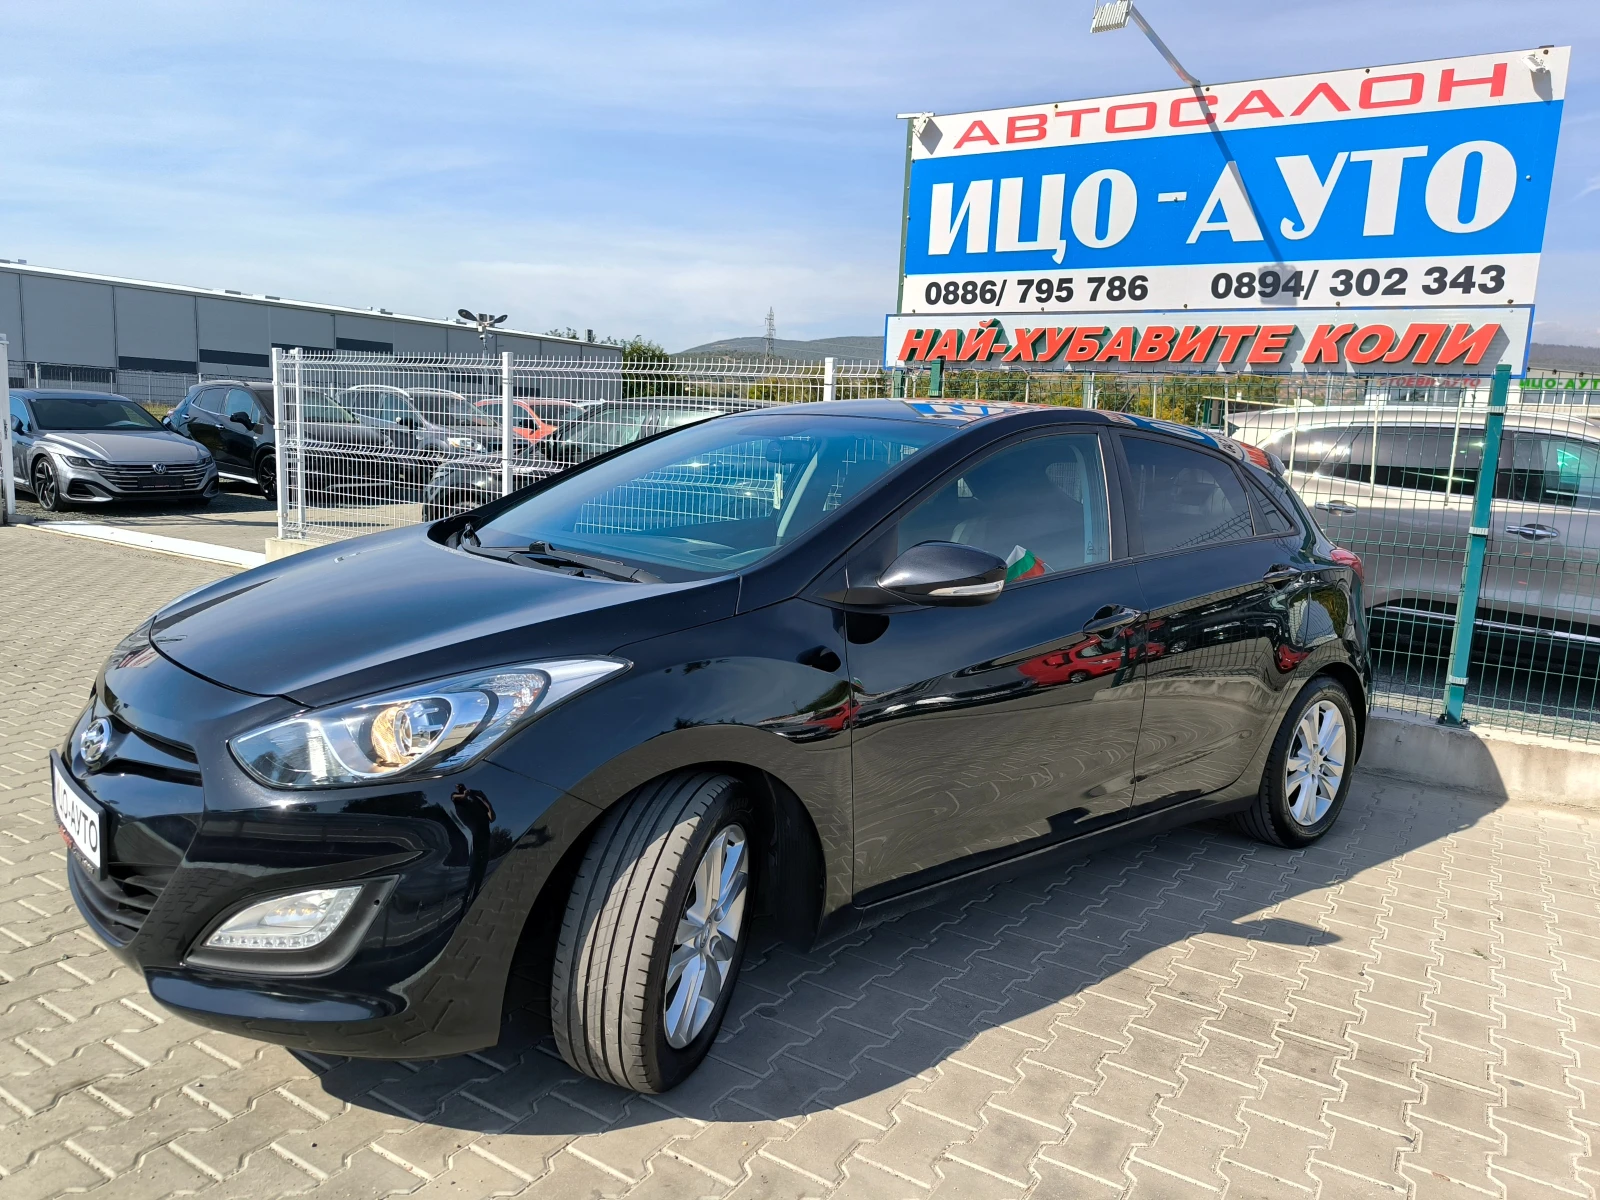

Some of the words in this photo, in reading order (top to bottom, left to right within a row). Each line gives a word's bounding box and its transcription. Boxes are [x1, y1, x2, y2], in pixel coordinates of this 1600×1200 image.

[952, 62, 1509, 150] АВТОСАЛОН
[924, 279, 1007, 306] 0886/
[1016, 275, 1075, 304] 795
[1086, 274, 1150, 301] 786
[1210, 269, 1320, 300] 0894/
[1329, 267, 1409, 297] 302
[1421, 264, 1506, 295] 343
[897, 318, 1298, 365] НАЙ-ХУБАВИТЕ
[1301, 322, 1502, 365] КОЛИ
